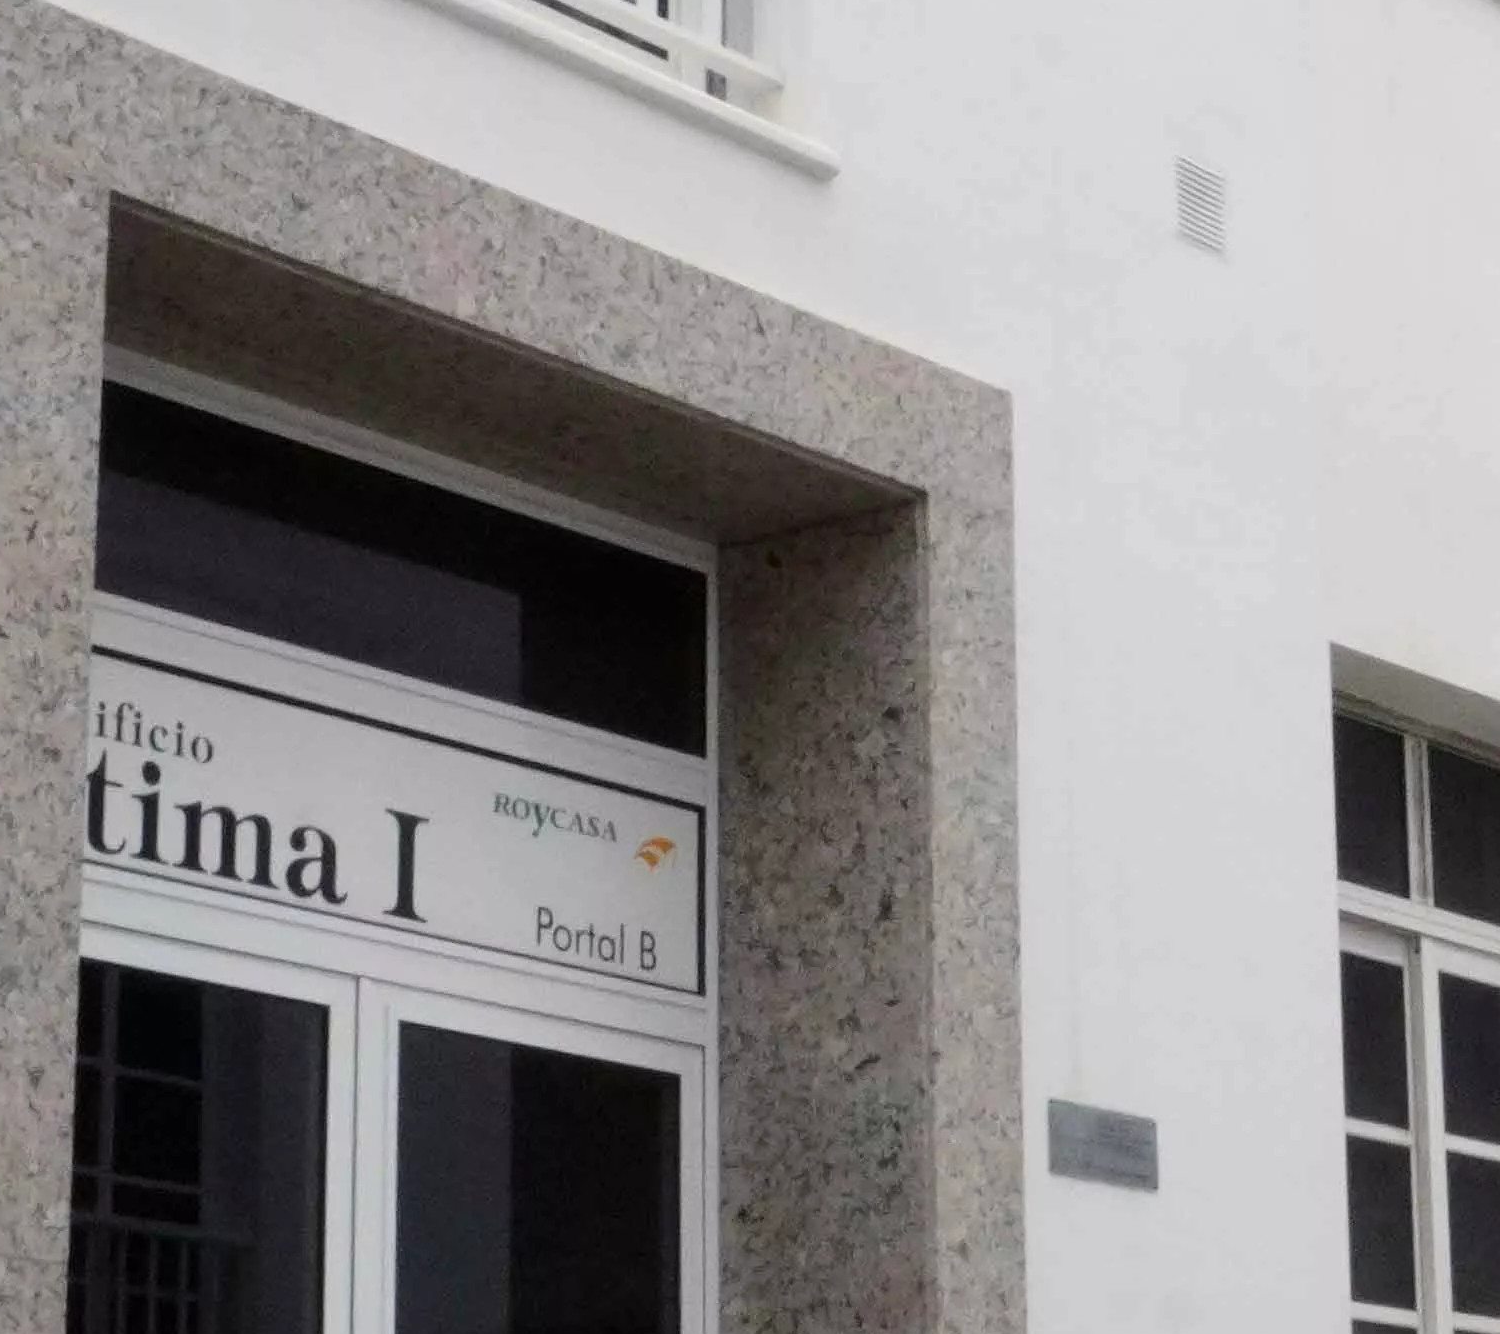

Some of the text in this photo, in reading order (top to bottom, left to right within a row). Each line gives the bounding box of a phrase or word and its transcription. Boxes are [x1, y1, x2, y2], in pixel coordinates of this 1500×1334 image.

[95, 700, 215, 764] ificio
[86, 747, 430, 924] tima I
[535, 906, 657, 971] Portal B
